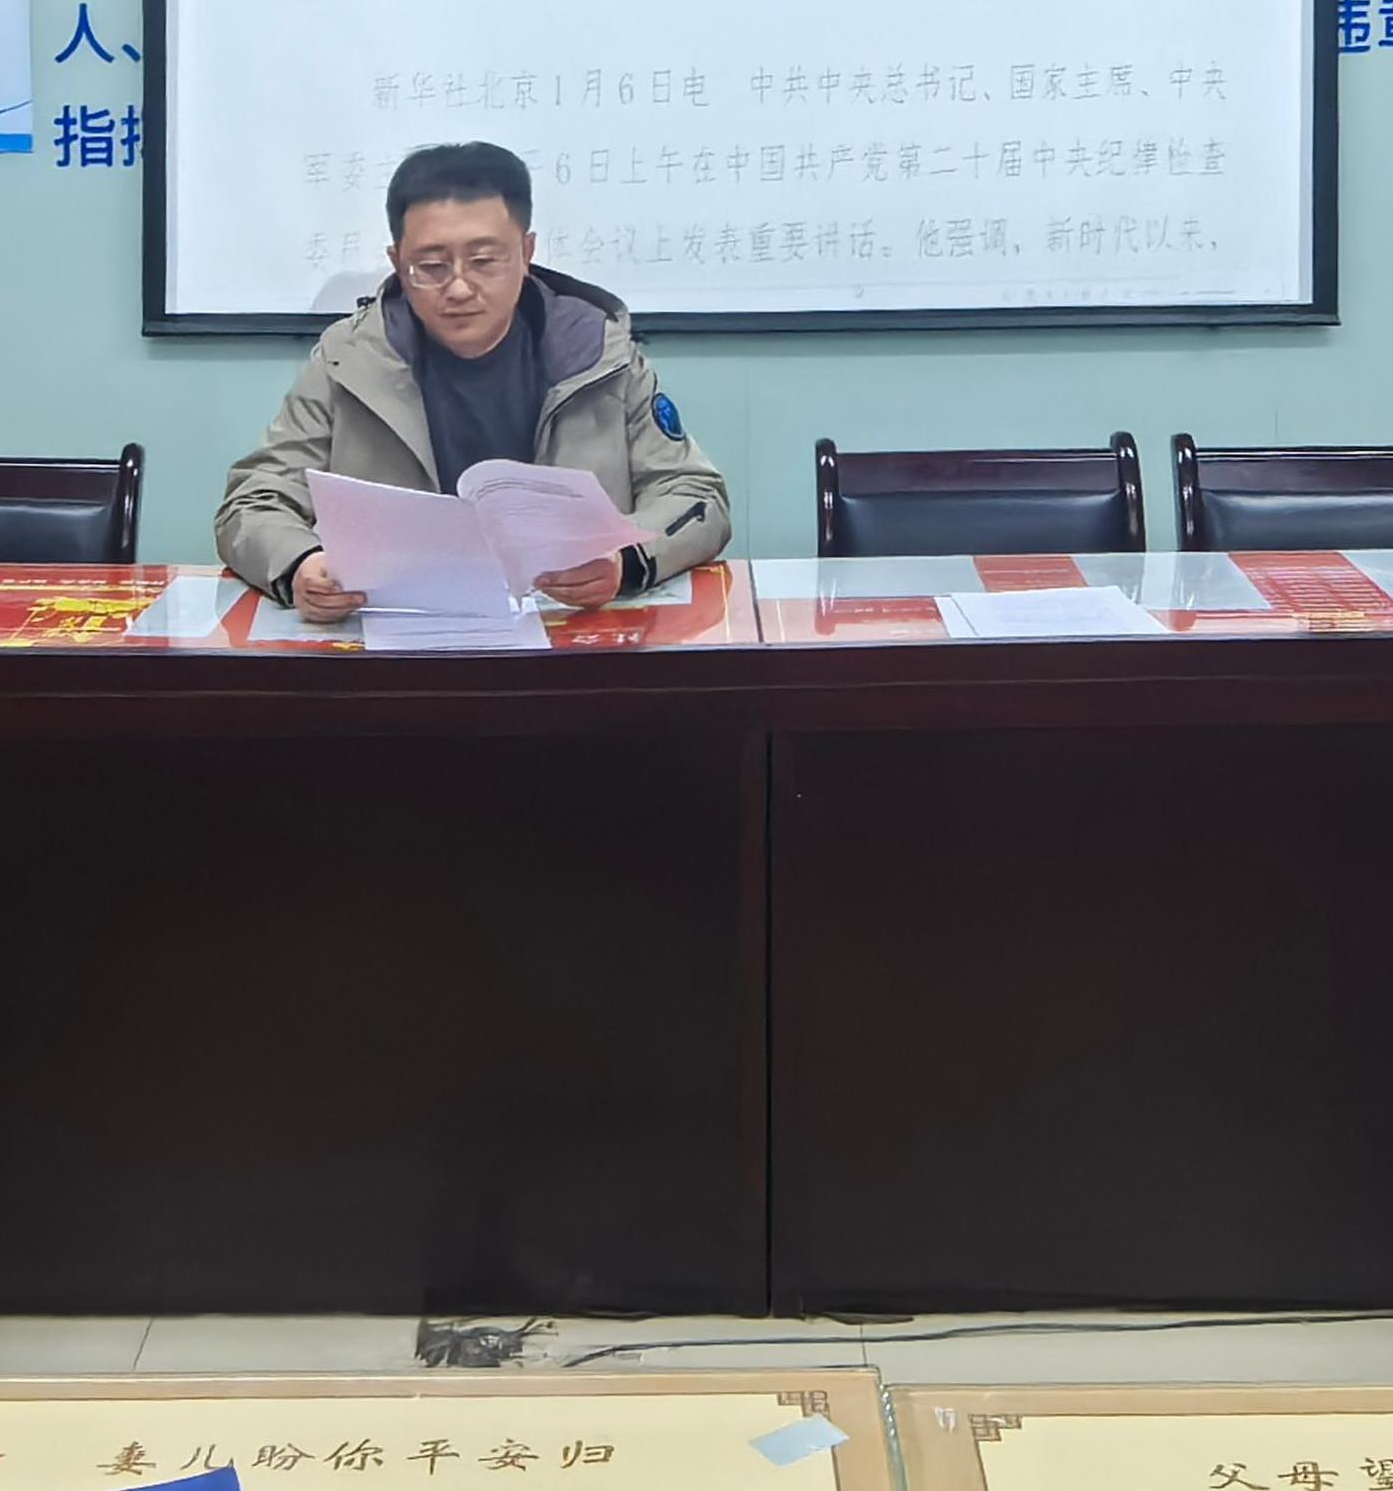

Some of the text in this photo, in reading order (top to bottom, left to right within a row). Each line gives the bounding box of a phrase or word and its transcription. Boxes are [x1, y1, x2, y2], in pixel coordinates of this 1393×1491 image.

[97, 1437, 616, 1477] 妻儿盼你平安归
